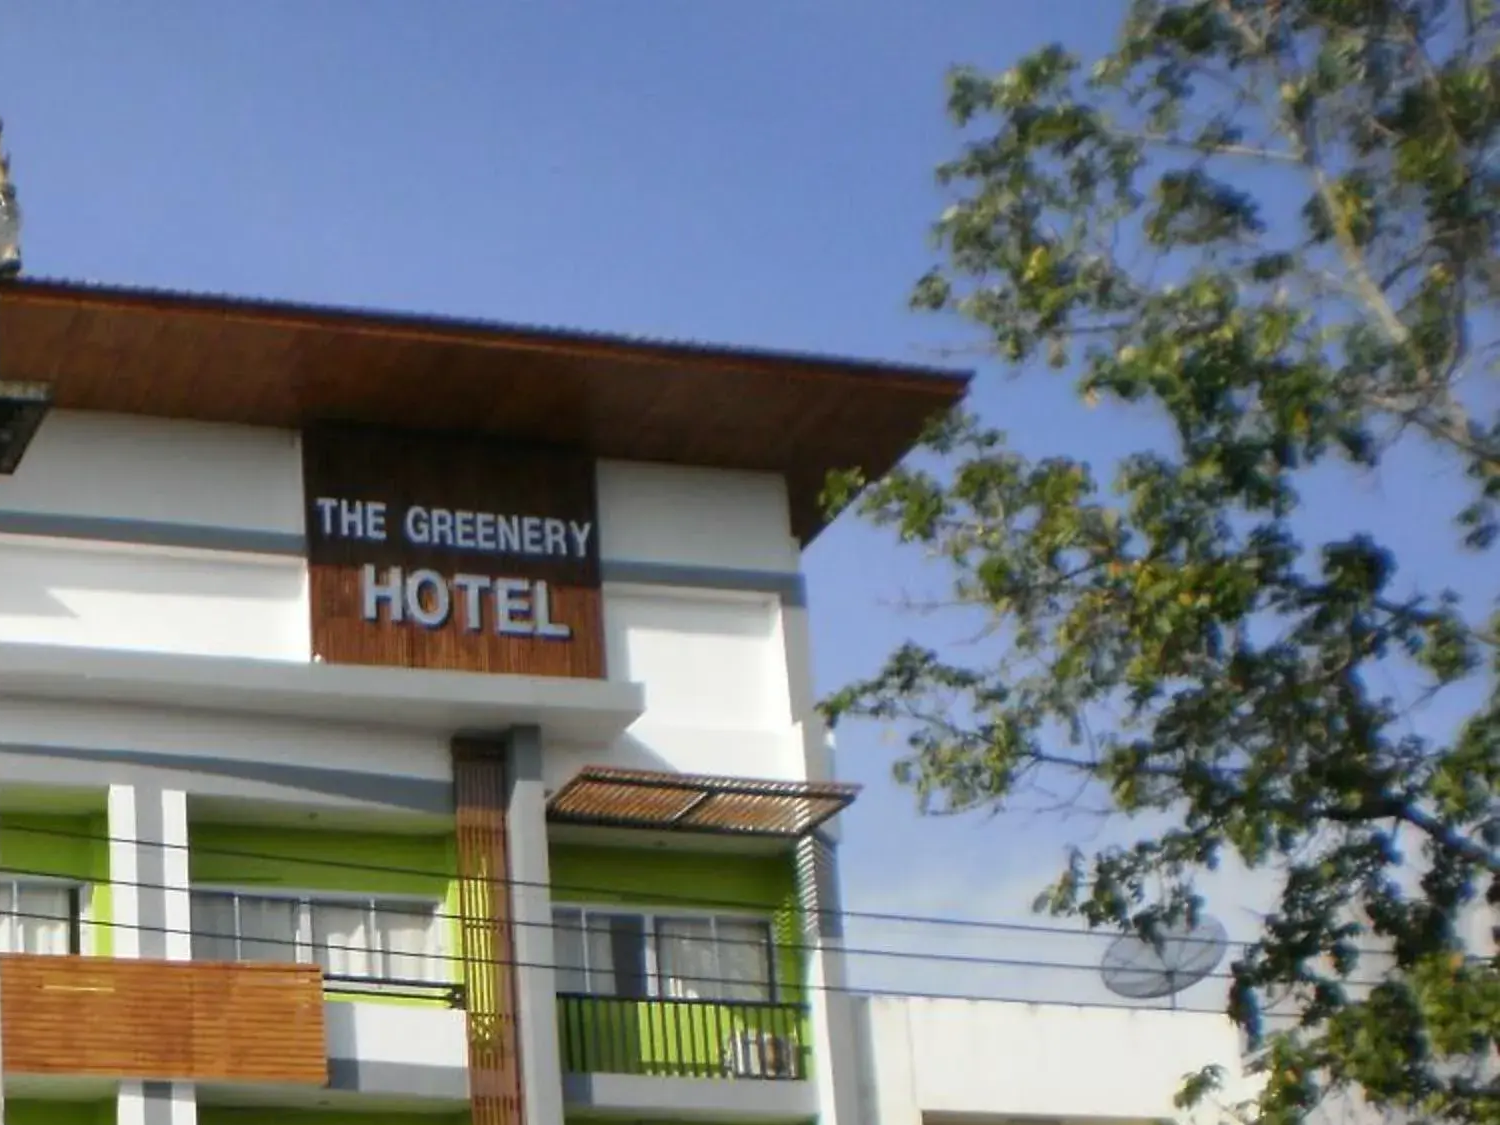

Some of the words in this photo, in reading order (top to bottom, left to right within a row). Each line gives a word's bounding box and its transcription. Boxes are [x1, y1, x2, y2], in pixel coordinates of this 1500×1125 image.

[317, 498, 387, 540] THE
[405, 505, 592, 557] GREENERY
[361, 563, 572, 637] HOTEL
